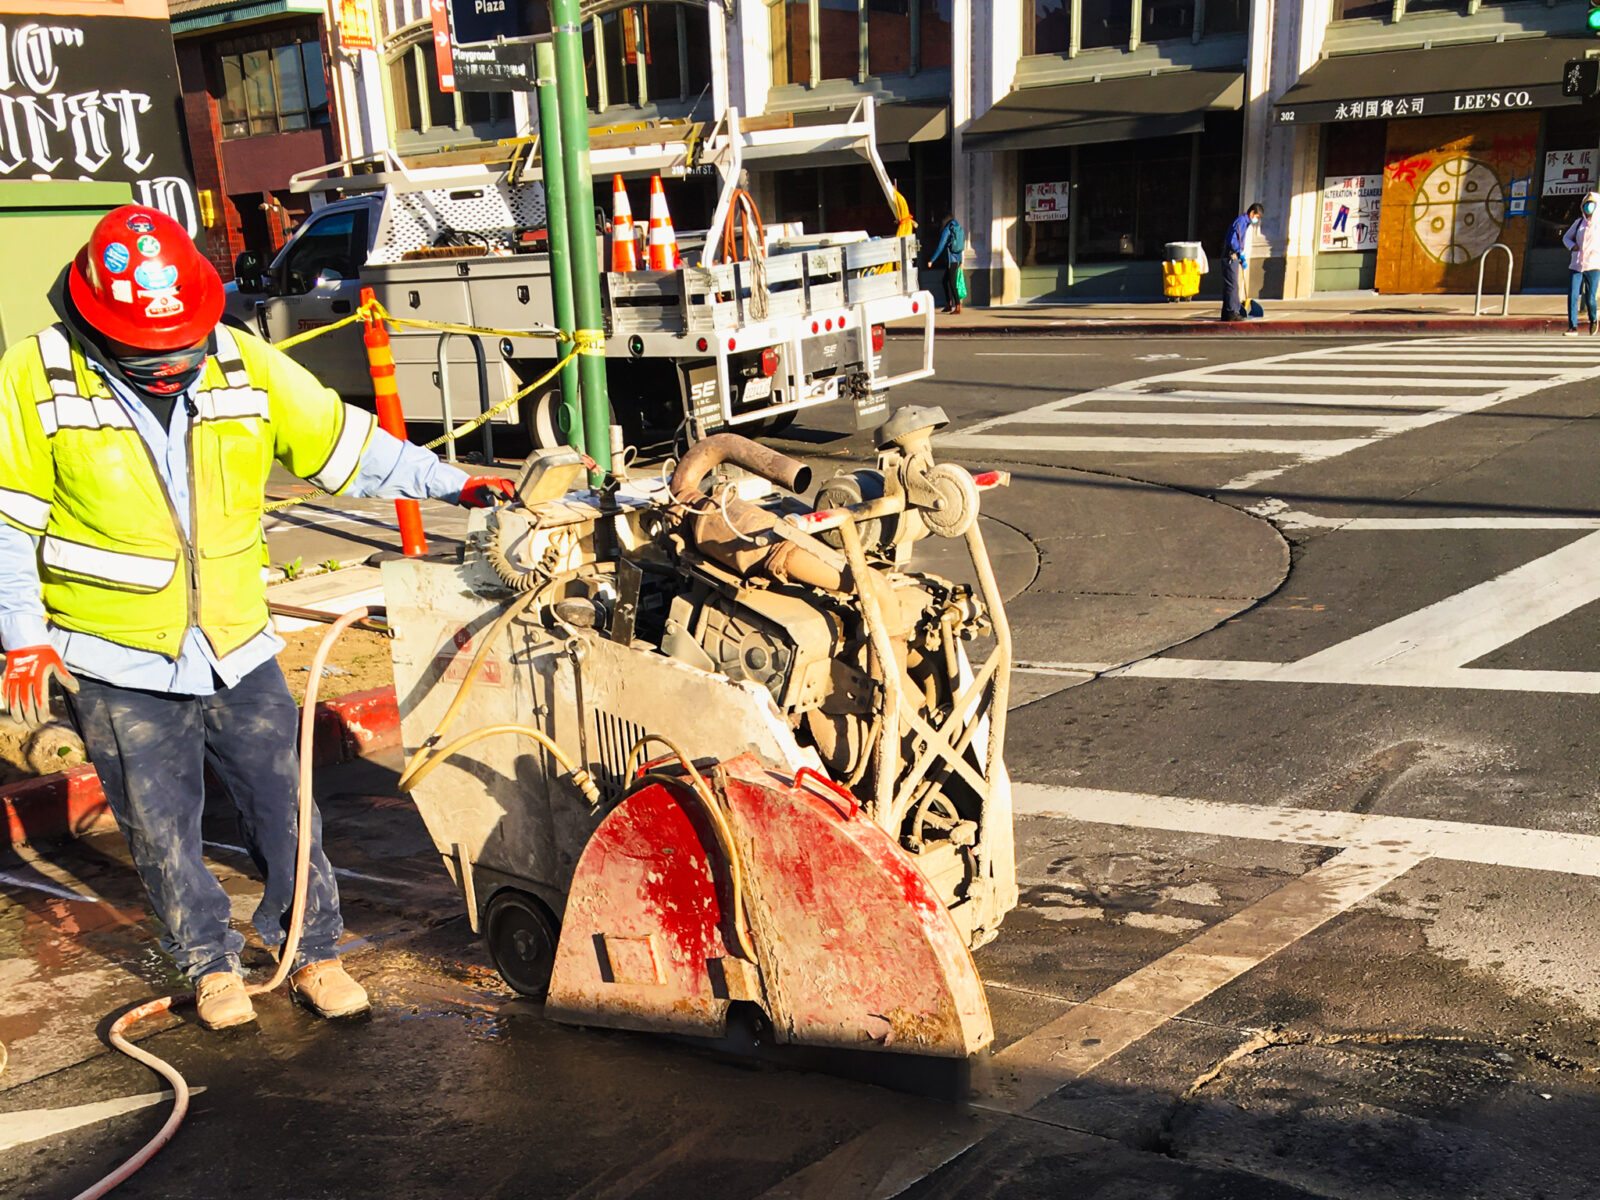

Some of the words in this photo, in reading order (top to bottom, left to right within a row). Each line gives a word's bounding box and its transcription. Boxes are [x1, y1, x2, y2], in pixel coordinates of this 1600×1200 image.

[475, 0, 505, 14] Plaza
[452, 48, 496, 63] Playground
[1335, 97, 1424, 120] 永利国貨公司
[1453, 92, 1501, 111] LEE’S
[1504, 91, 1533, 107] CO.
[1280, 111, 1295, 121] 302
[823, 344, 838, 355] SE
[690, 379, 717, 401] SE
